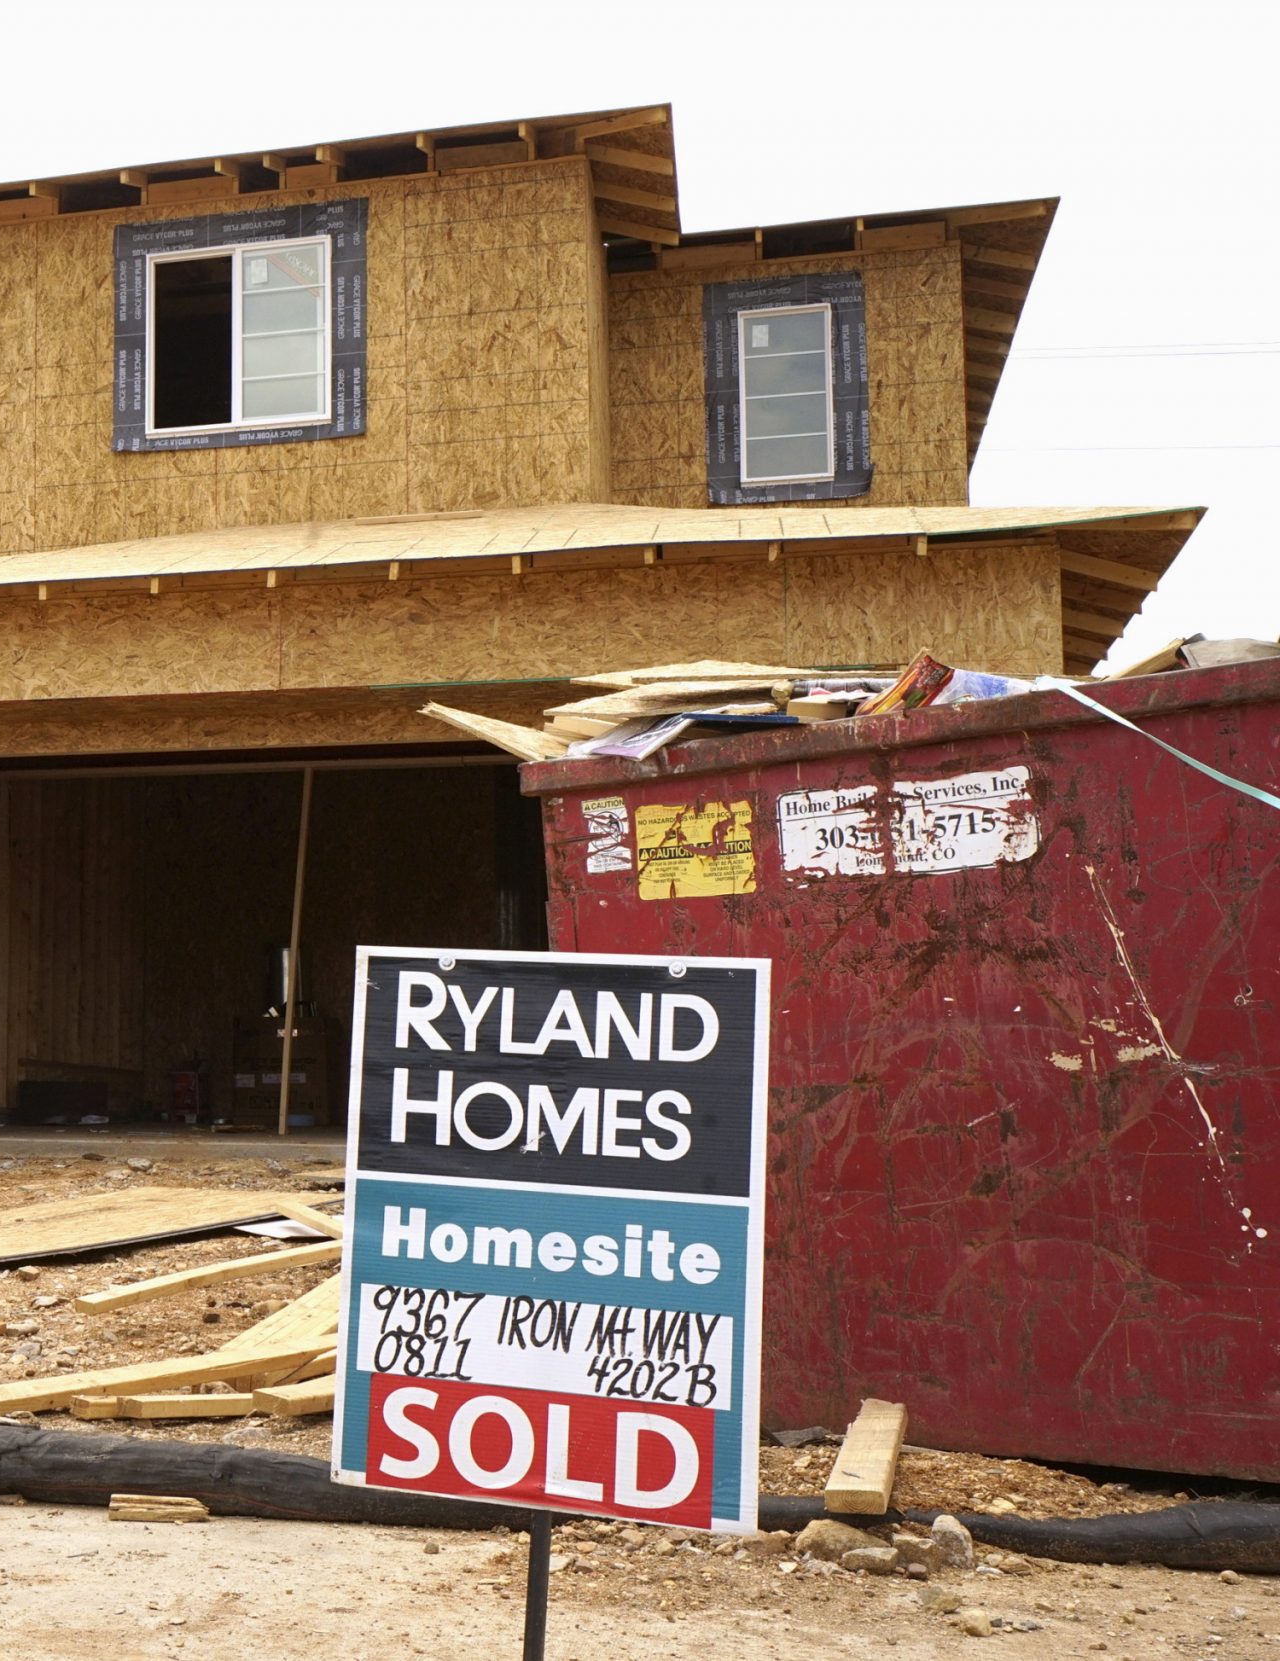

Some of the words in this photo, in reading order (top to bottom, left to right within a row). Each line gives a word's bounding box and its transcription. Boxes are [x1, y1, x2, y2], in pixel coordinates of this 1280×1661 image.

[649, 815, 687, 824] HAZARDS
[785, 800, 830, 816] Home
[913, 782, 987, 800] Services,
[992, 777, 1024, 792] Inc.
[932, 847, 955, 861] CO
[395, 970, 719, 1062] RYLAND
[391, 1067, 692, 1161] HOMES
[382, 1205, 721, 1285] Homesite
[374, 1285, 485, 1341] 9367
[497, 1295, 582, 1353] IRON
[642, 1308, 720, 1364] WAY
[374, 1330, 472, 1380] 0811
[379, 1386, 700, 1509] SOLD
